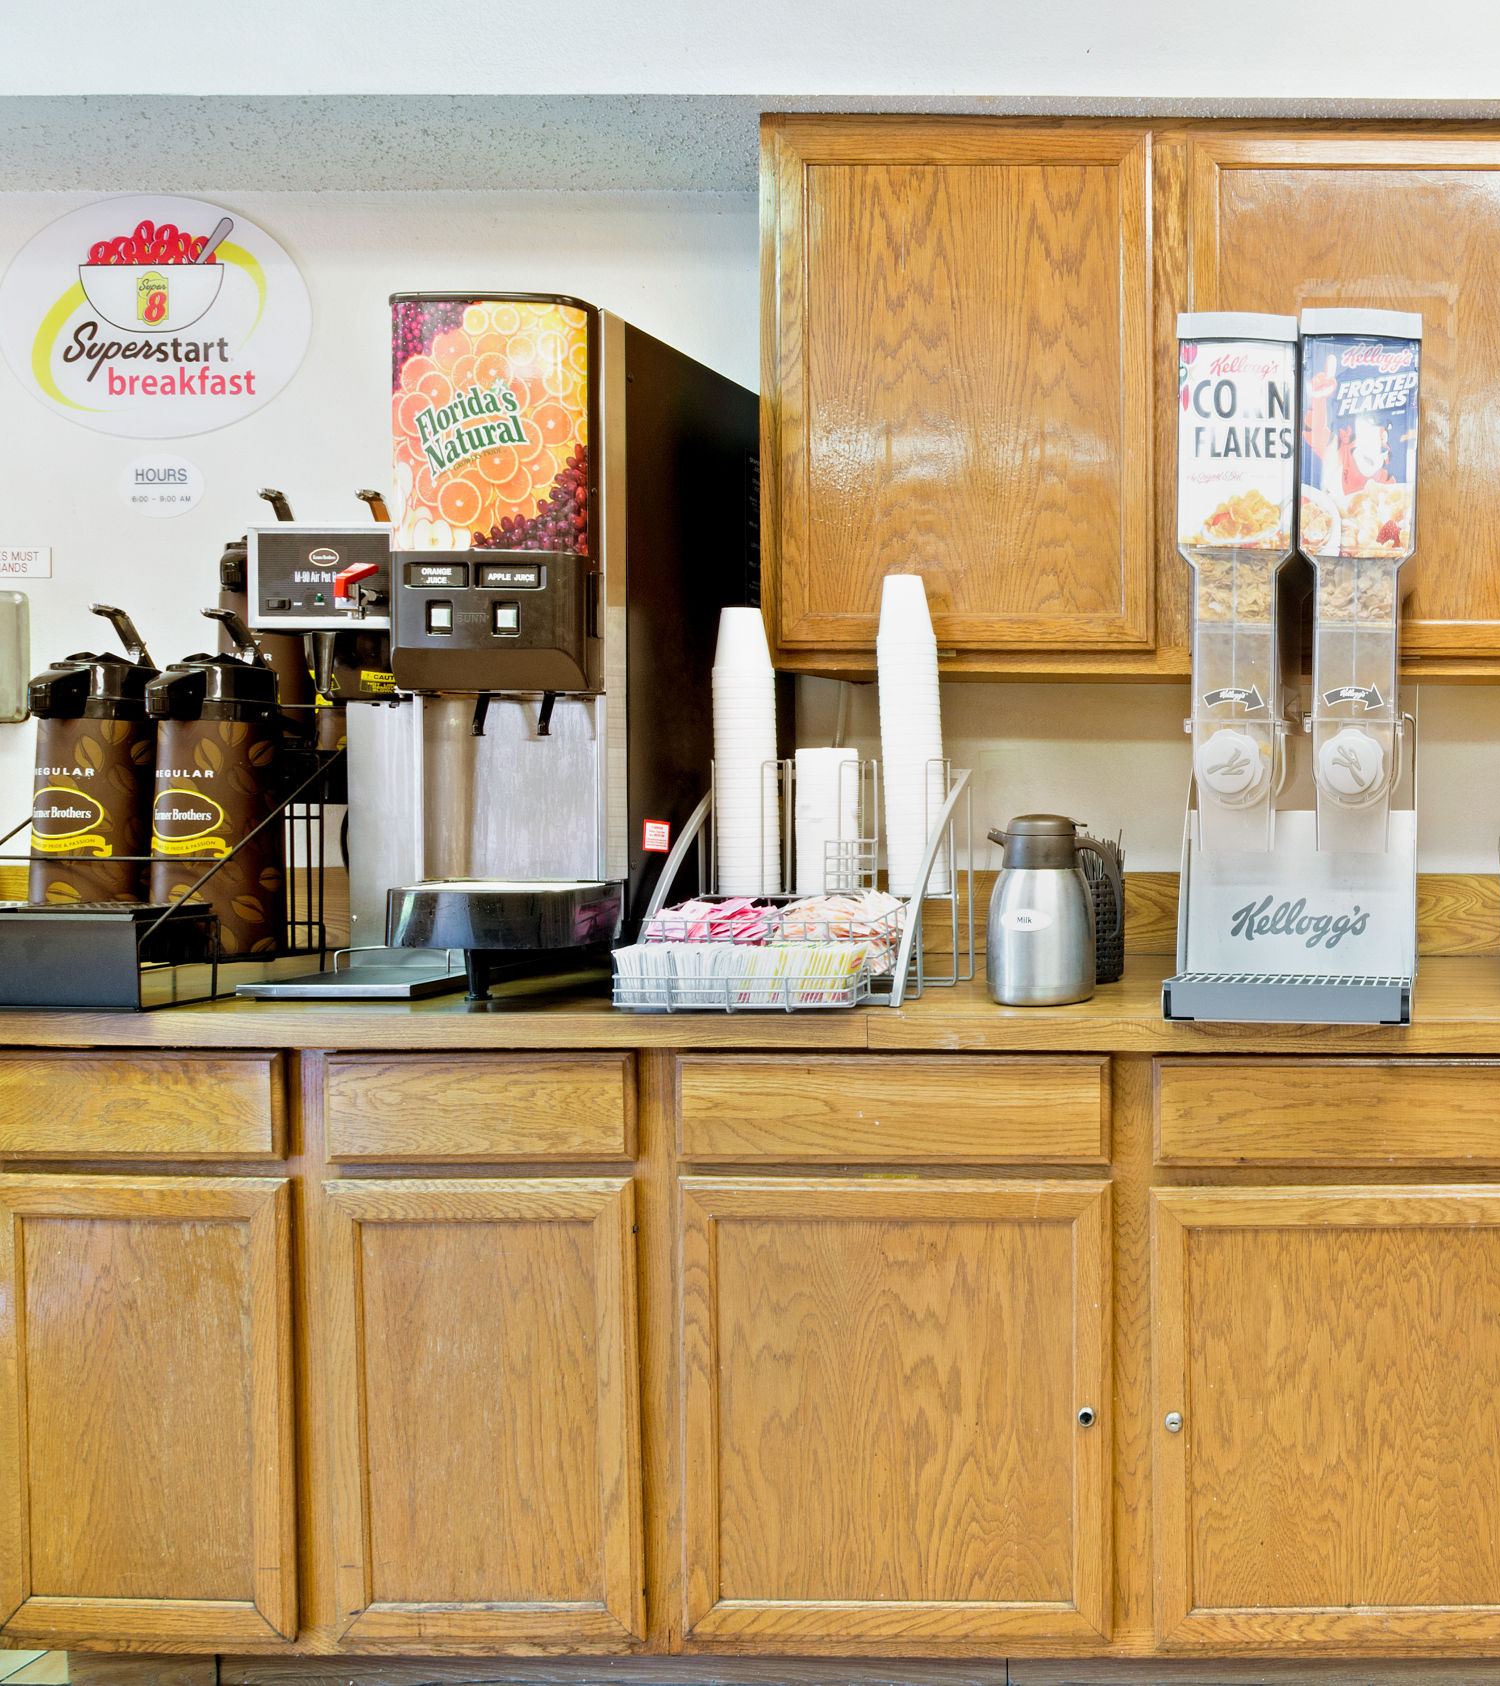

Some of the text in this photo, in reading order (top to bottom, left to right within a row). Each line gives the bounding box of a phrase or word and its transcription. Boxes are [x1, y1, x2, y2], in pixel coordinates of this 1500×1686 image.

[139, 278, 166, 296] Super
[143, 292, 167, 322] 8
[63, 321, 229, 382] Superstart
[1342, 343, 1413, 373] Kellogg's
[108, 366, 256, 396] breakfast
[1336, 371, 1417, 400] FROSTED
[1193, 379, 1290, 420] CON
[1337, 389, 1410, 416] FLAKES
[425, 415, 528, 477] Natural
[1195, 426, 1293, 459] FLAKES
[135, 468, 188, 482] HOURS
[11, 551, 40, 561] MUST
[0, 562, 28, 573] ANDS
[421, 567, 452, 576] ORANGE
[311, 571, 320, 583] Air
[426, 576, 447, 584] JUICE
[487, 573, 535, 581] APPLE JUICE
[33, 767, 95, 777] EGULAR
[51, 806, 92, 819] Brothers
[172, 808, 212, 821] Brothers
[1017, 916, 1032, 924] Milk
[1230, 894, 1370, 949] Kellogg's
